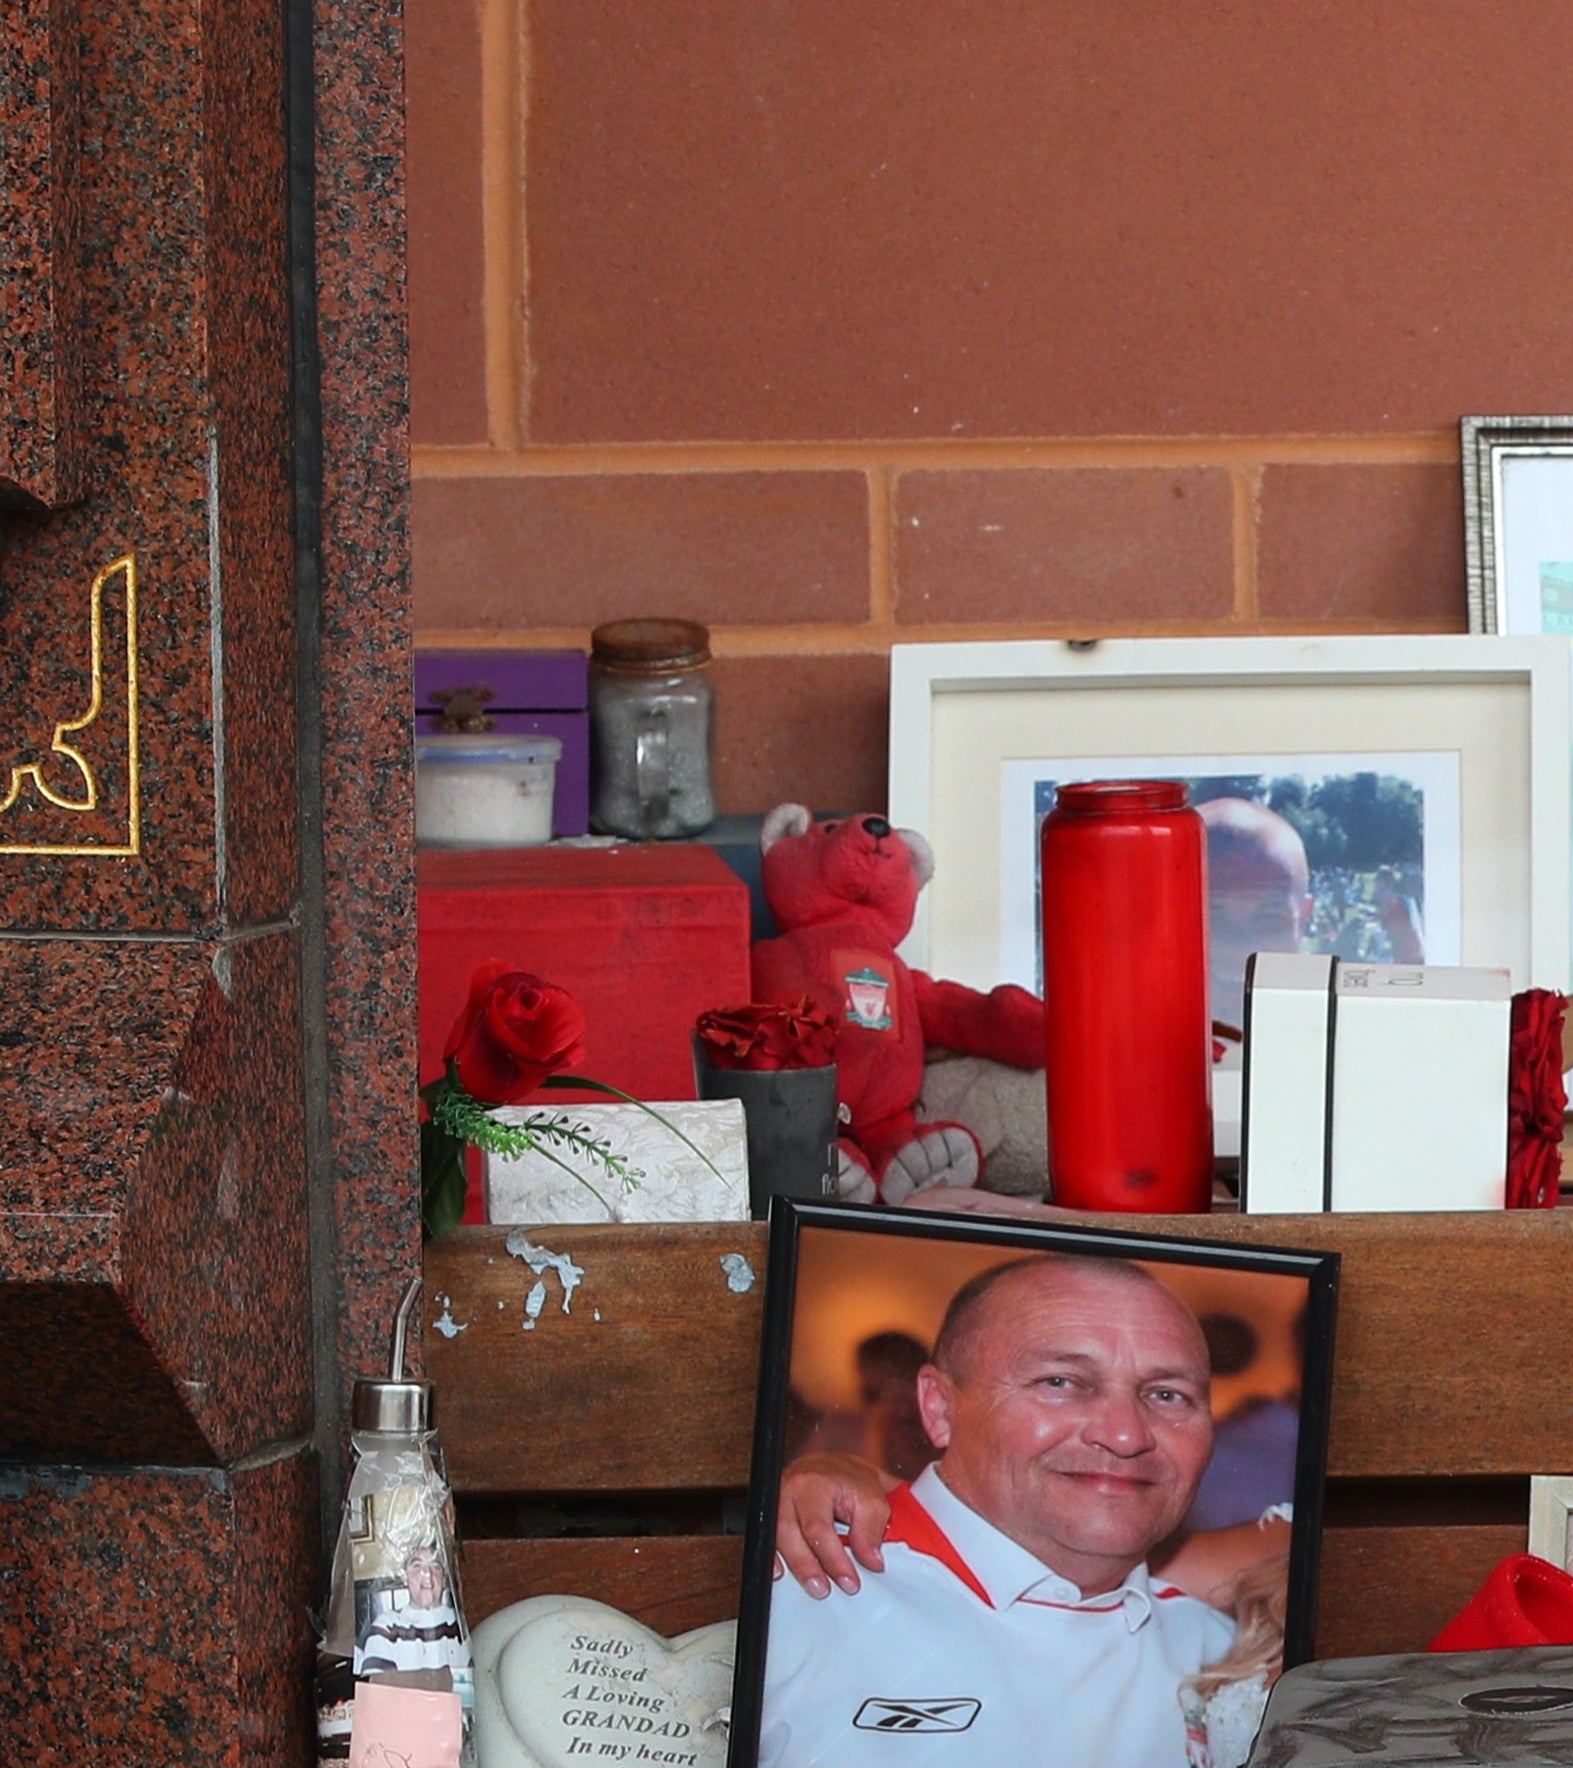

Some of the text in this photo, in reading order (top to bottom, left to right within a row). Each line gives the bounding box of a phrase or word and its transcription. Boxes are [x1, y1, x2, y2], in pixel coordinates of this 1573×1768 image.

[570, 1635, 634, 1659] Sadly
[567, 1658, 648, 1682] Missed
[562, 1684, 665, 1714] A Loving
[562, 1709, 691, 1739] GRANDAD
[566, 1736, 697, 1767] In my heart
